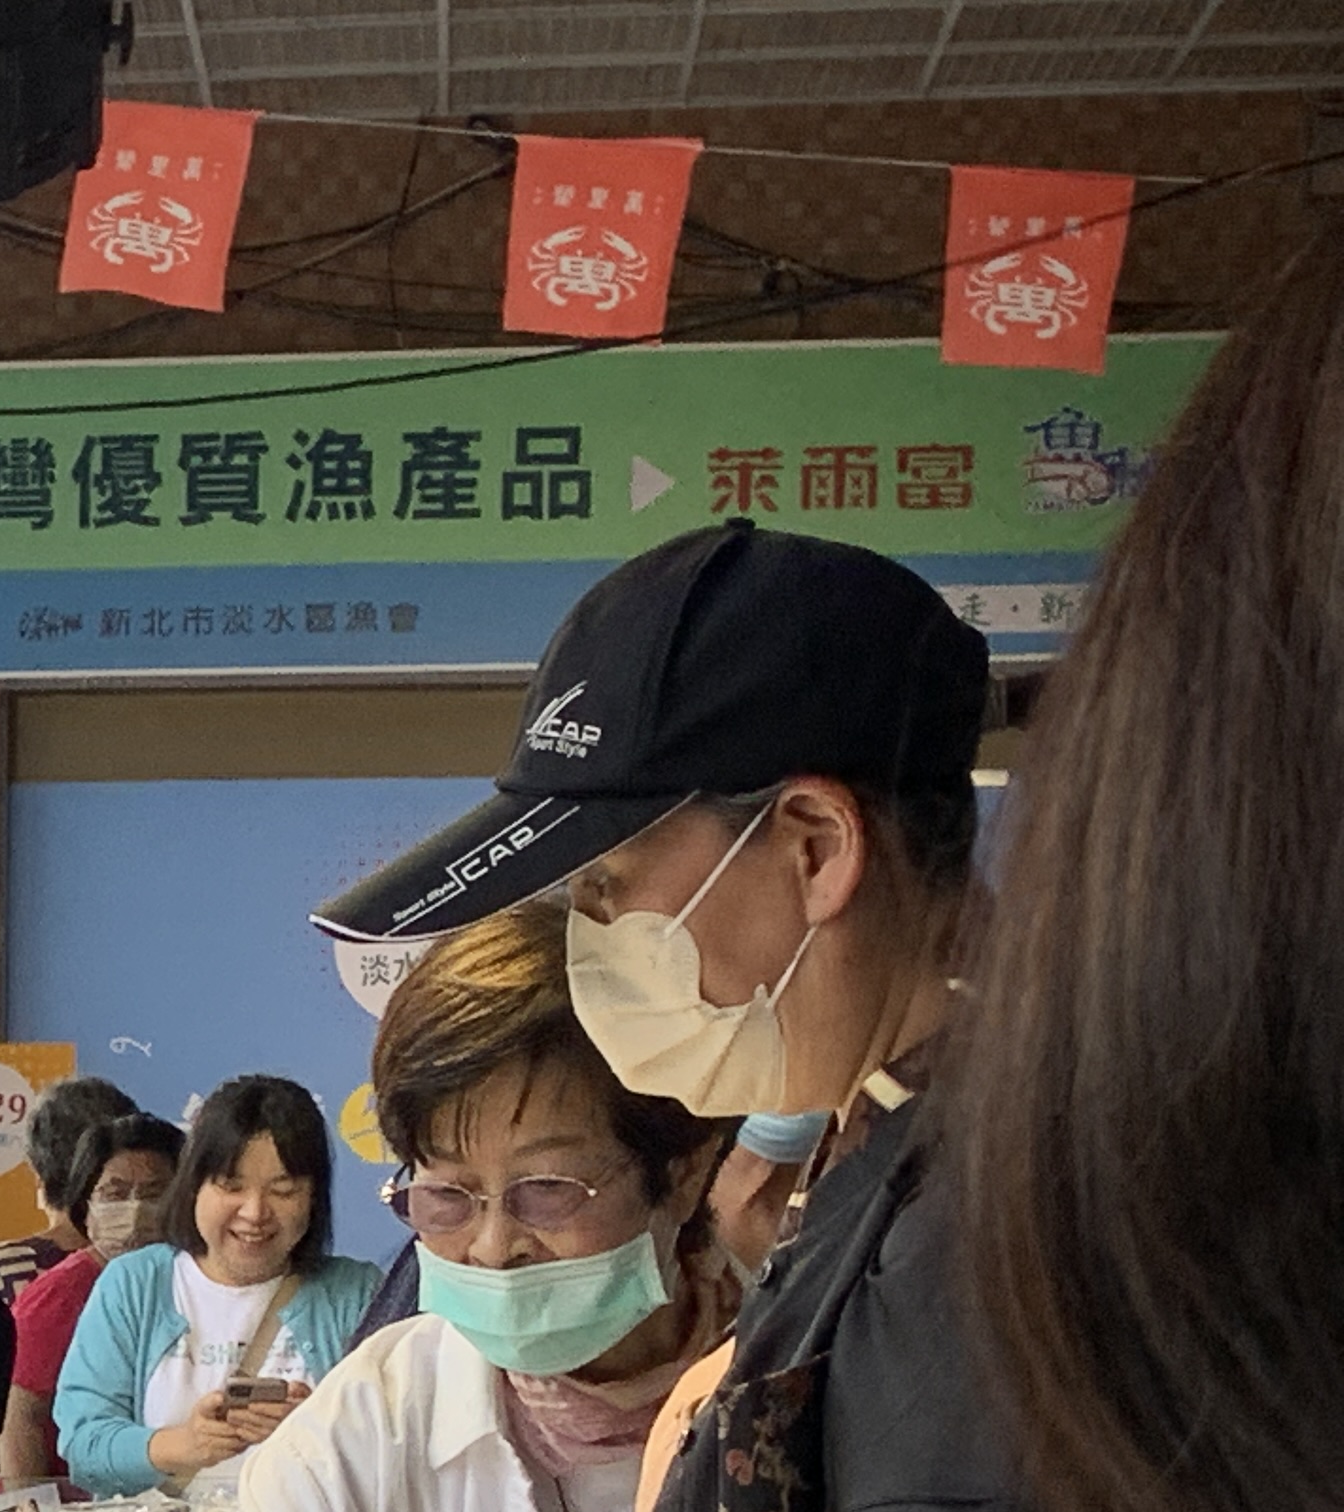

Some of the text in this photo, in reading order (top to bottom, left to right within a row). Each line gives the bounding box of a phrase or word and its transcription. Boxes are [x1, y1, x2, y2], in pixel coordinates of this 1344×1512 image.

[99, 603, 420, 638] 新北市淡水區漁會
[461, 826, 534, 881] CAP
